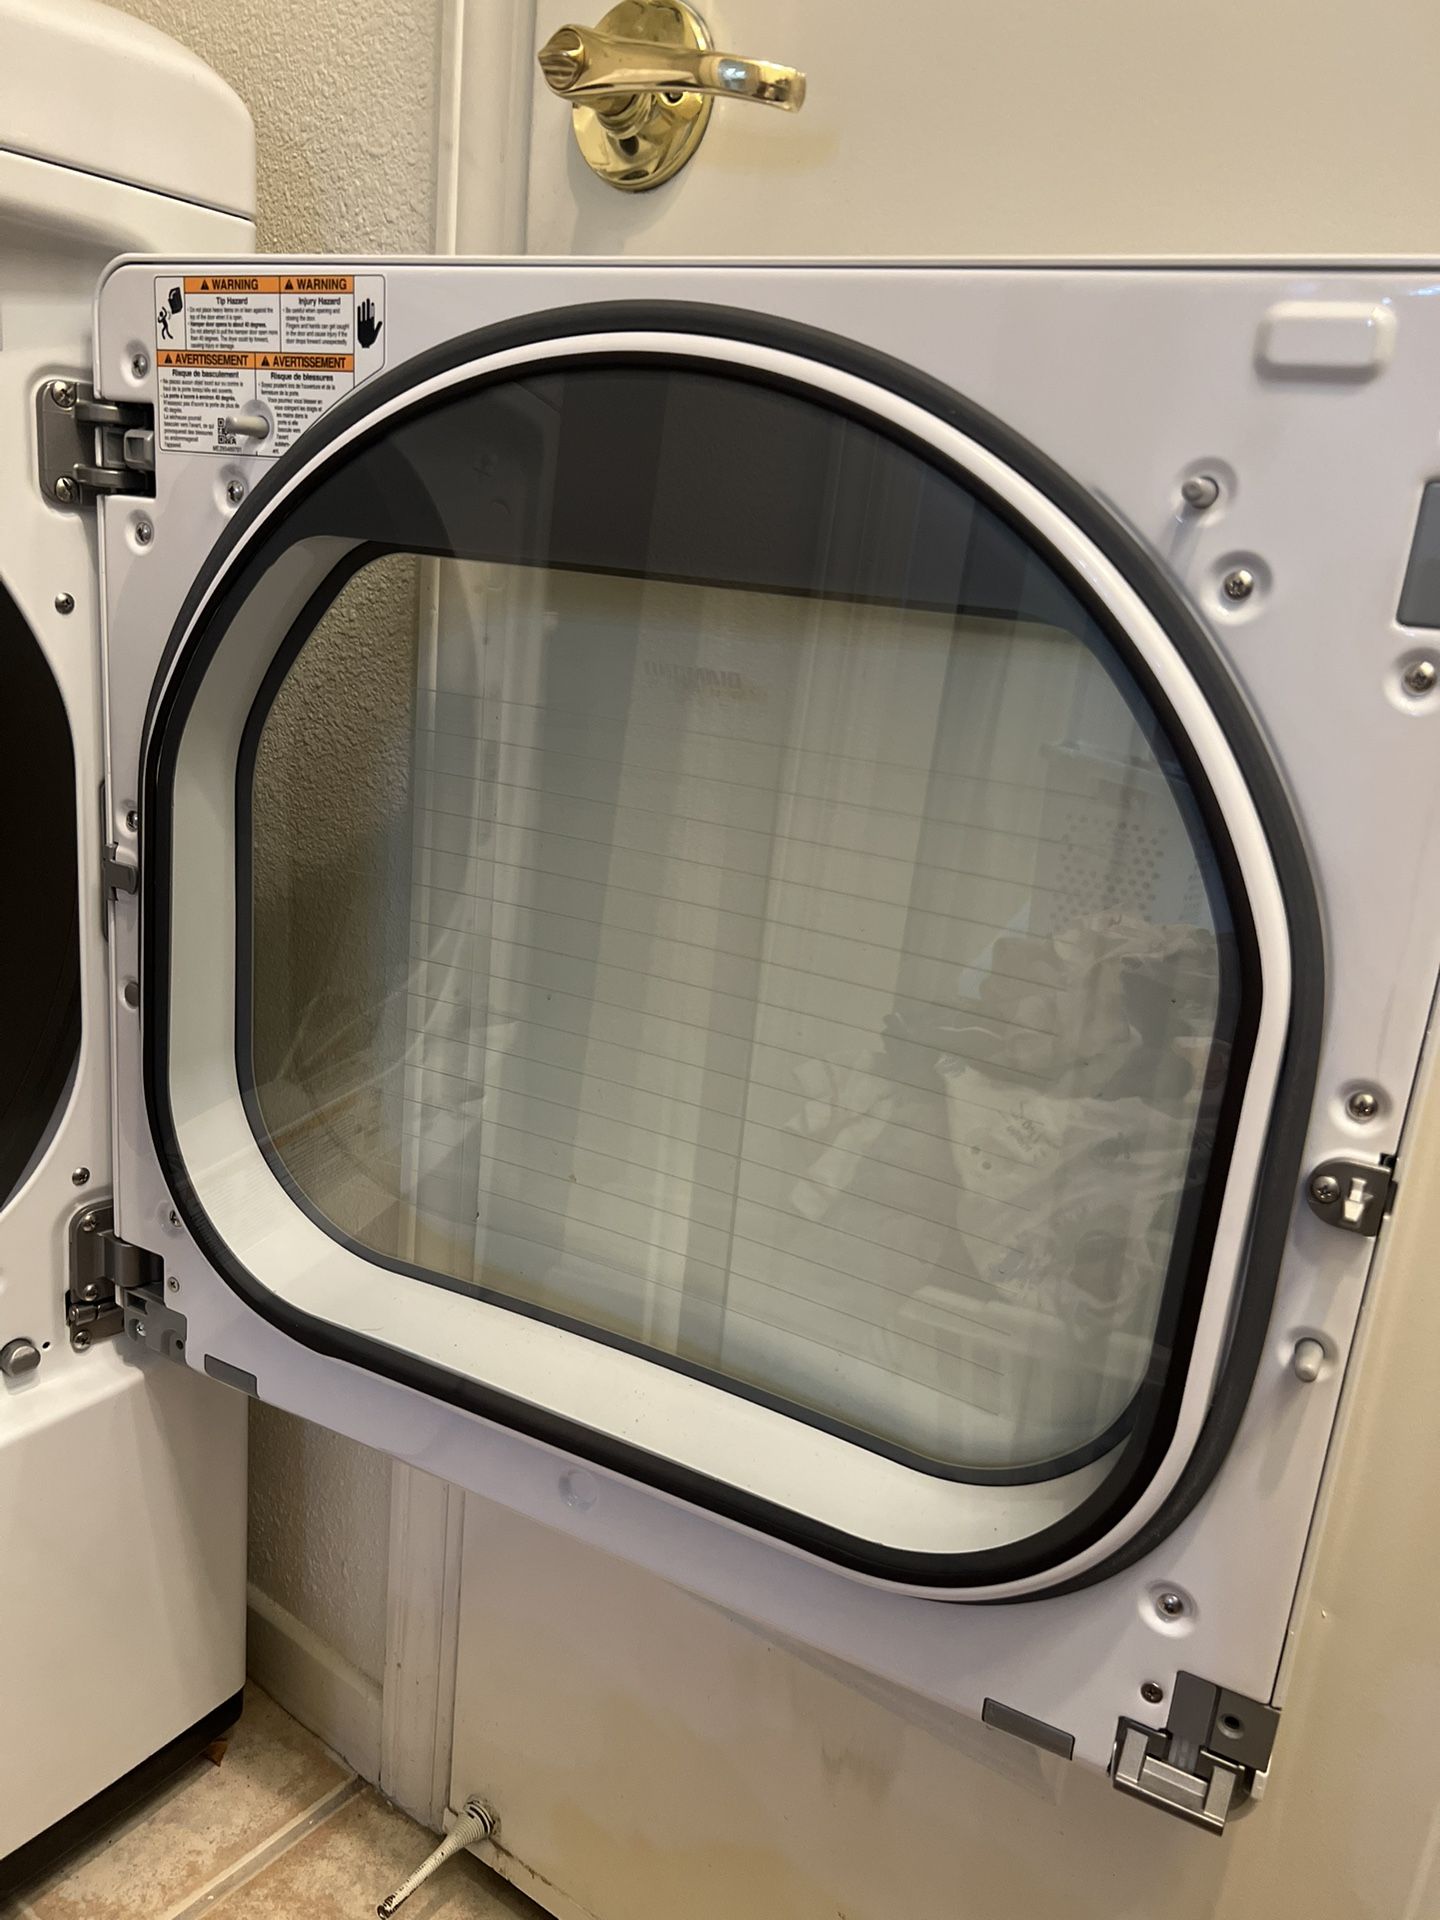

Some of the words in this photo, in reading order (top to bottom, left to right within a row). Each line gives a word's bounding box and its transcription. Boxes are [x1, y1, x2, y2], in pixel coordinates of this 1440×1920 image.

[211, 279, 259, 290] WARNING
[296, 279, 347, 290] WARNING
[216, 296, 226, 306] Tip
[227, 296, 249, 304] Hazard
[298, 297, 317, 307] Injury
[318, 297, 341, 305] Hazard
[175, 353, 249, 366] AVERTISSEMENT
[272, 355, 346, 369] AVERTISSEMENT
[172, 368, 192, 378] Risque
[193, 369, 200, 377] de
[201, 370, 240, 378] basculement
[270, 372, 293, 382] Risque
[293, 373, 302, 381] de
[302, 373, 334, 382] blessures
